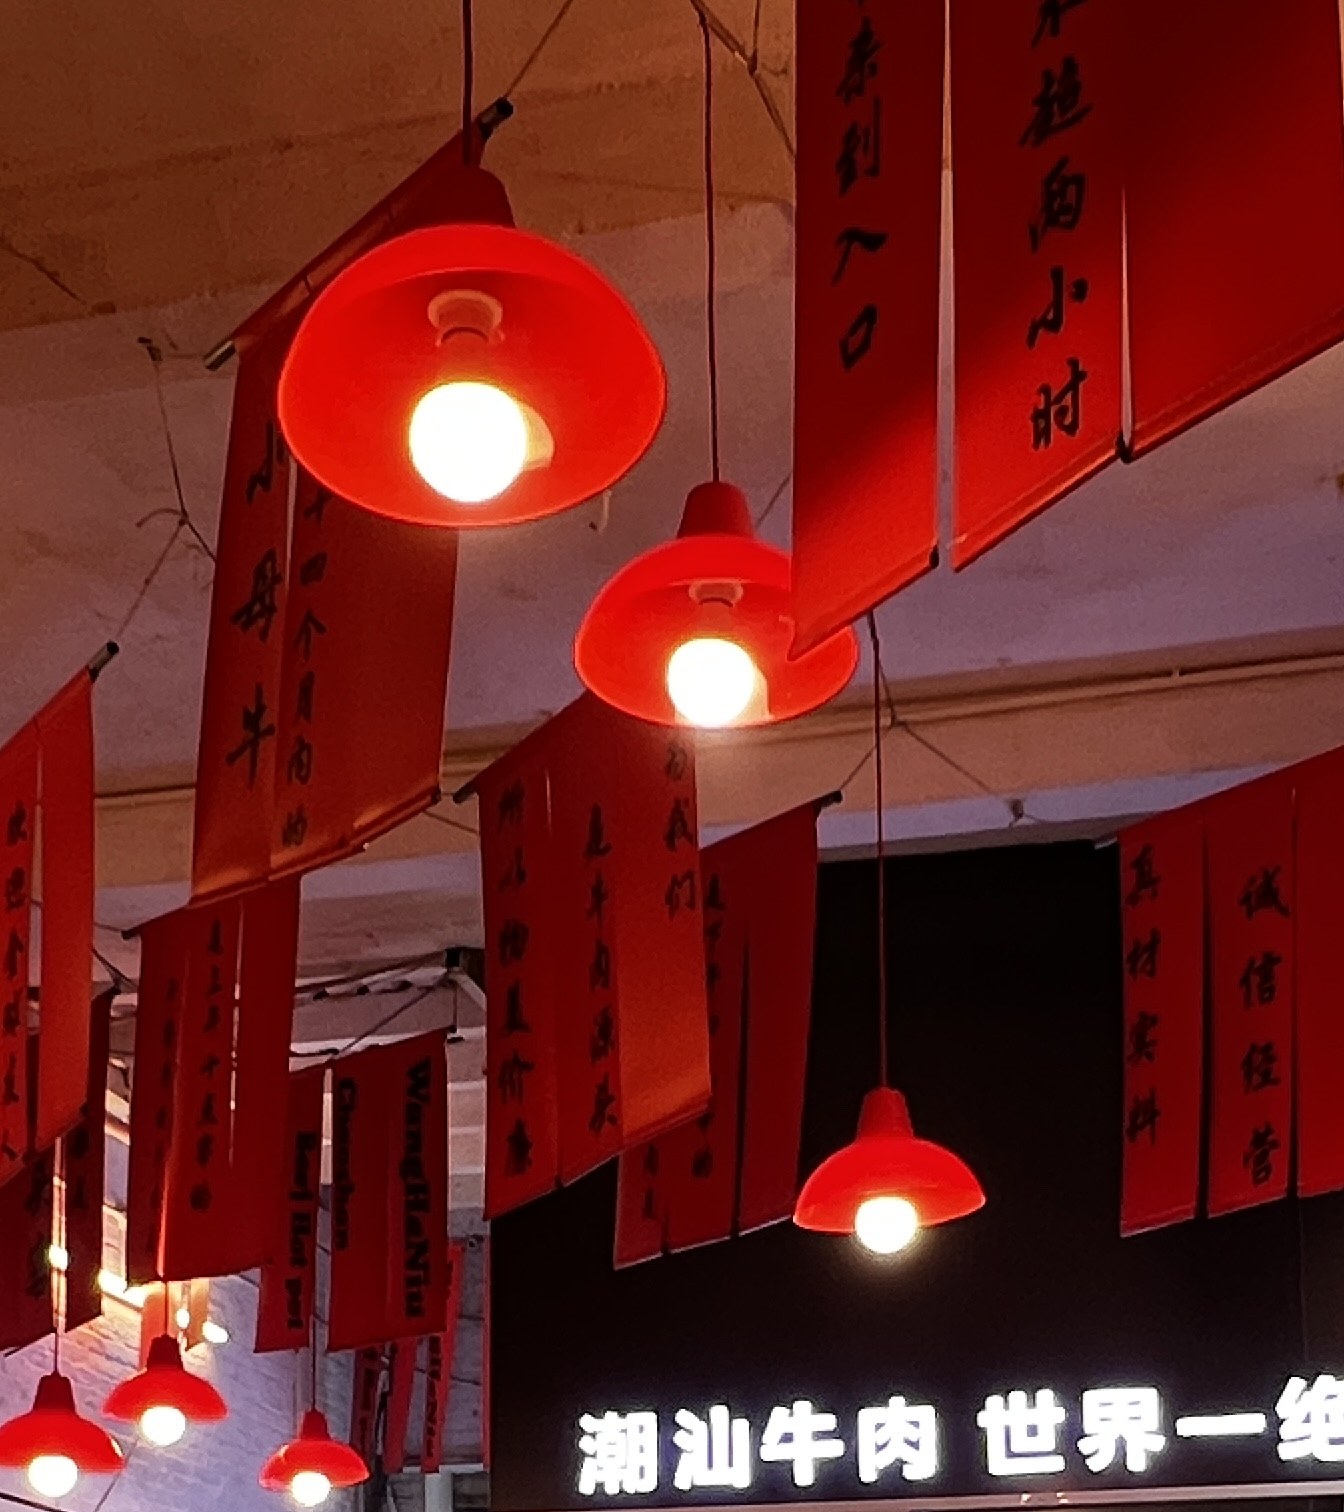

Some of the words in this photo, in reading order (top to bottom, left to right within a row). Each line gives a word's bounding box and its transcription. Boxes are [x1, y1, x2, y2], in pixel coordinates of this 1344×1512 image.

[1125, 844, 1161, 1147] 真材实料
[1239, 865, 1290, 1186] 诚信经营
[577, 1395, 939, 1496] 潮汕牛肉
